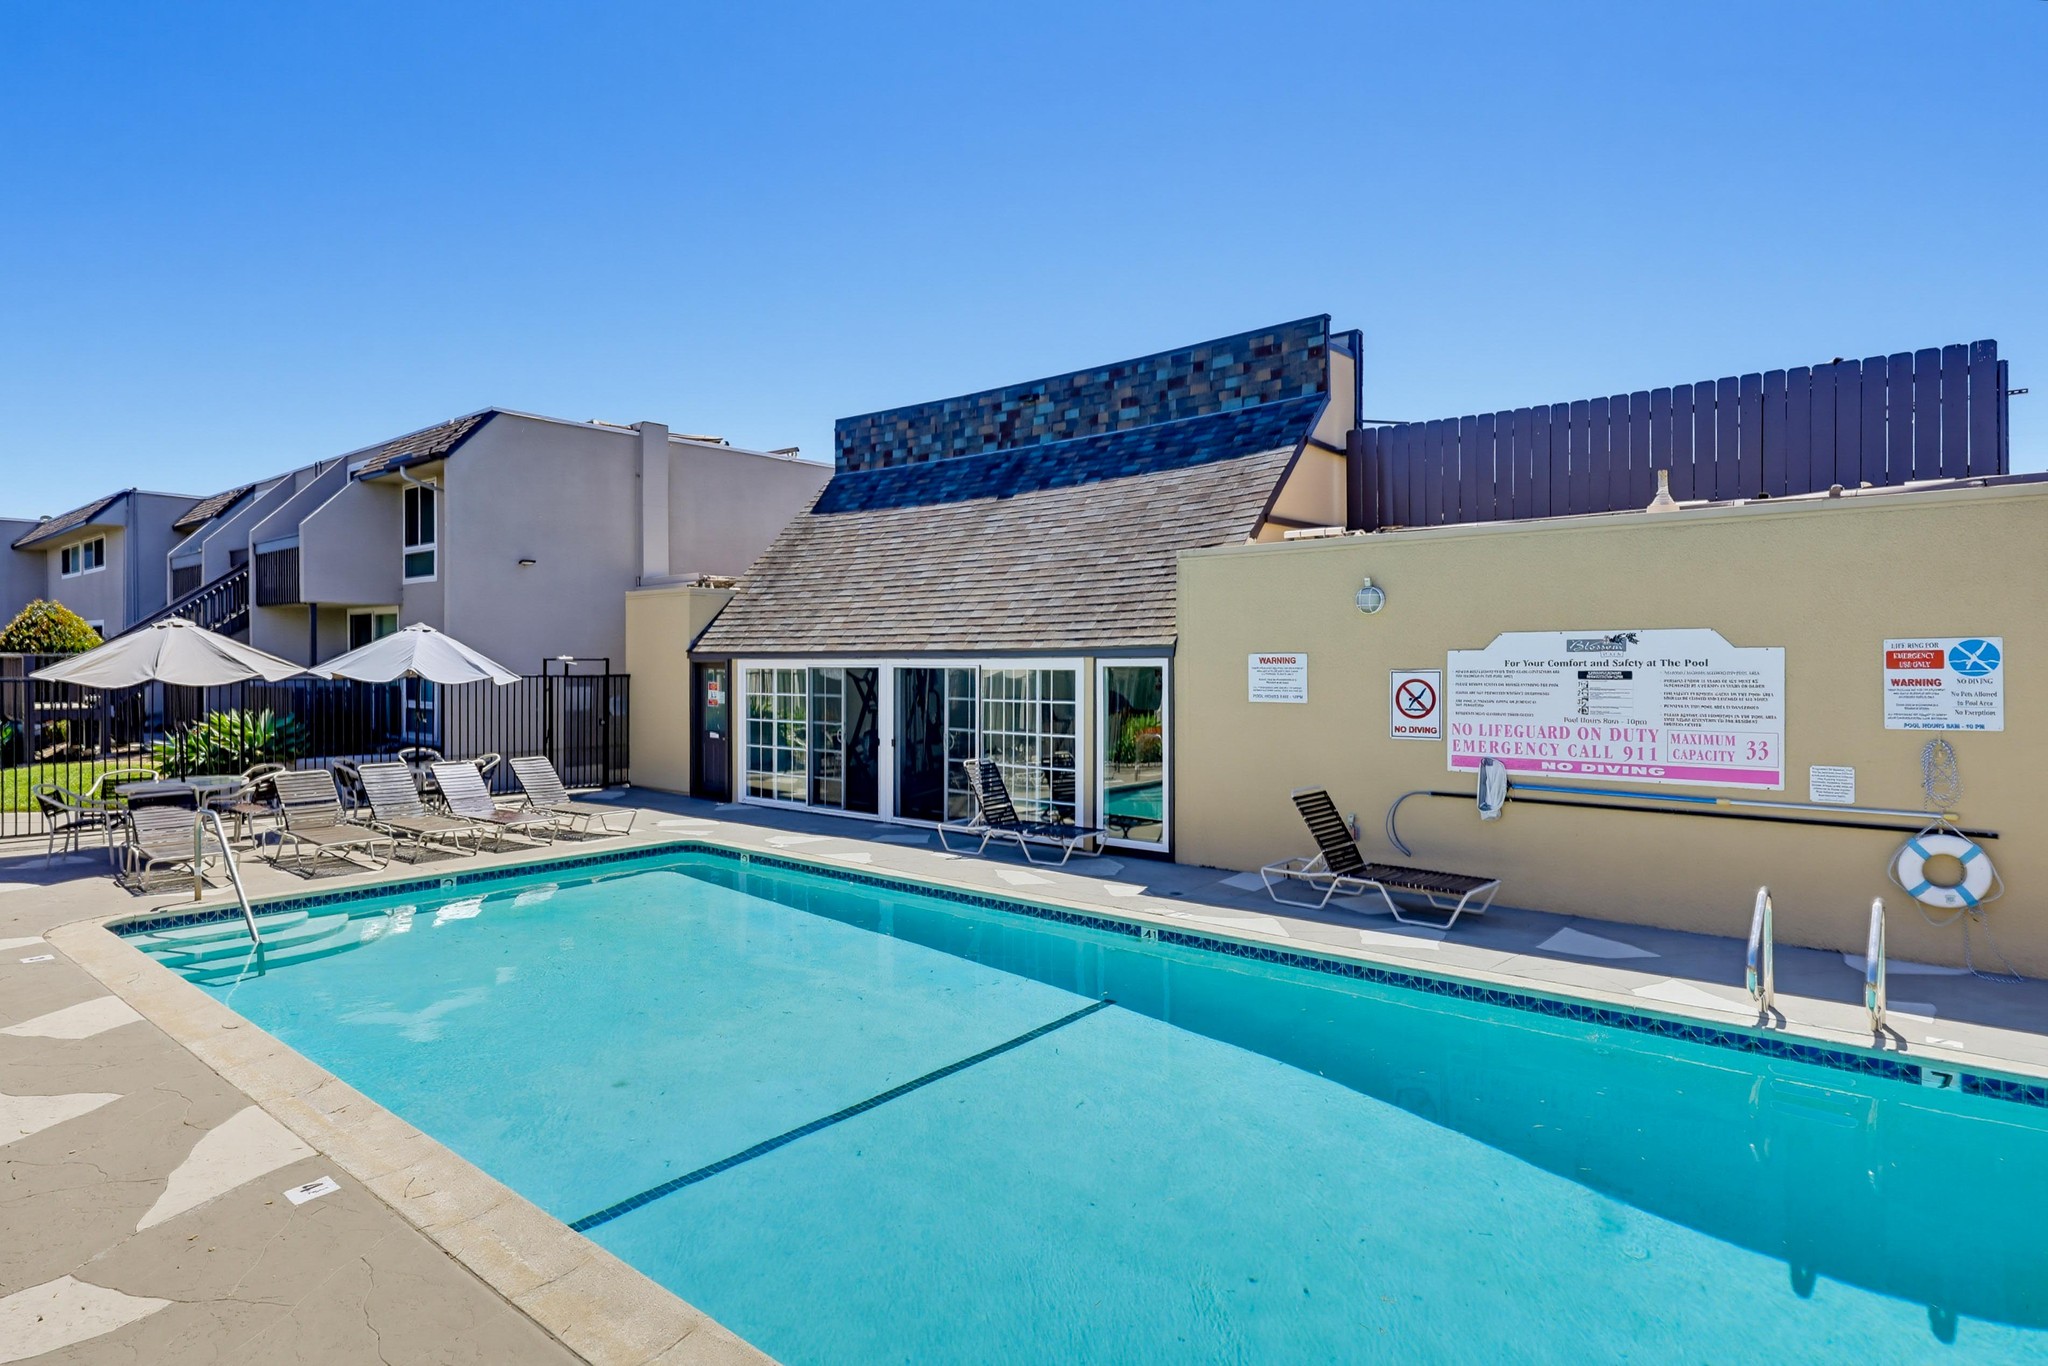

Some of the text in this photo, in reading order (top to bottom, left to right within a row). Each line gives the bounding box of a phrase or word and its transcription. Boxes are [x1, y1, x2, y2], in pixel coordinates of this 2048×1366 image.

[1569, 639, 1624, 652] Blossom
[1504, 658, 1709, 670] For Your Comfort and Safety at The Pool
[1890, 678, 1942, 687] WARNING
[1409, 726, 1437, 734] DIVING
[1451, 723, 1660, 744] NO LIFEGUARD ON DUTY
[1670, 733, 1736, 747] MAXIMUM
[1452, 738, 1658, 763] EMERGENCY CALL 911
[1672, 748, 1736, 762] CAPACITY
[1746, 740, 1769, 761] 33
[1541, 761, 1665, 776] NO DIVING
[1930, 1070, 1953, 1089] 7
